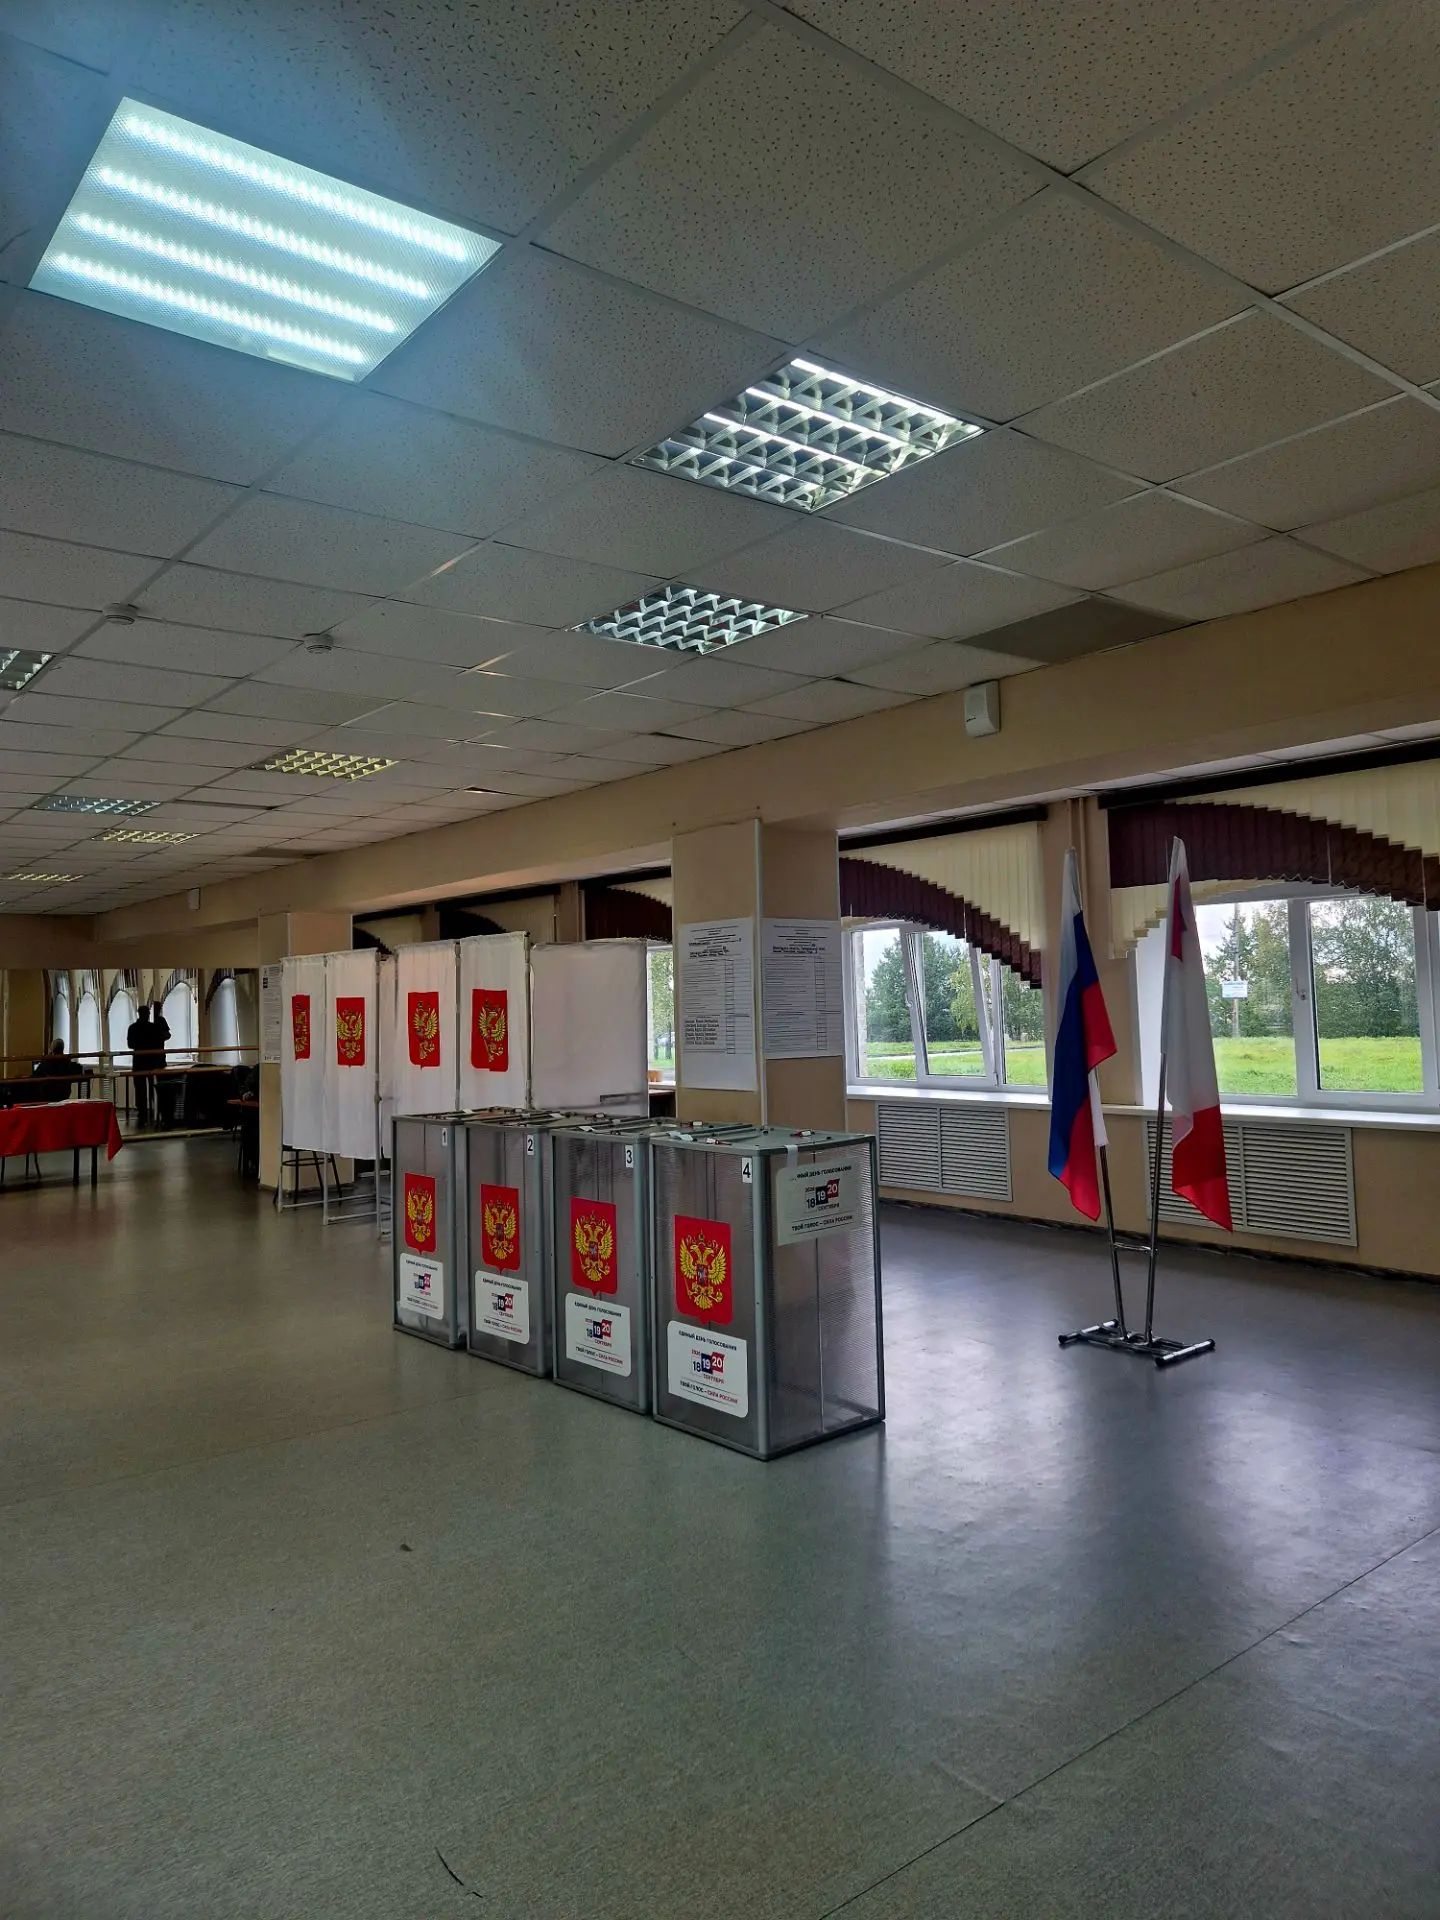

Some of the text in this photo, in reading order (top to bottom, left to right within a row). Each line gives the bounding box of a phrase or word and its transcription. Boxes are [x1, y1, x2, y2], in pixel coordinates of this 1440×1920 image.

[527, 1139, 533, 1151] 2
[626, 1150, 632, 1164] 3
[743, 1162, 751, 1178] 4
[806, 1184, 838, 1208] 18 19 20
[594, 1326, 600, 1335] 19
[602, 1323, 610, 1333] 20
[693, 1357, 722, 1372] 18 19 20
